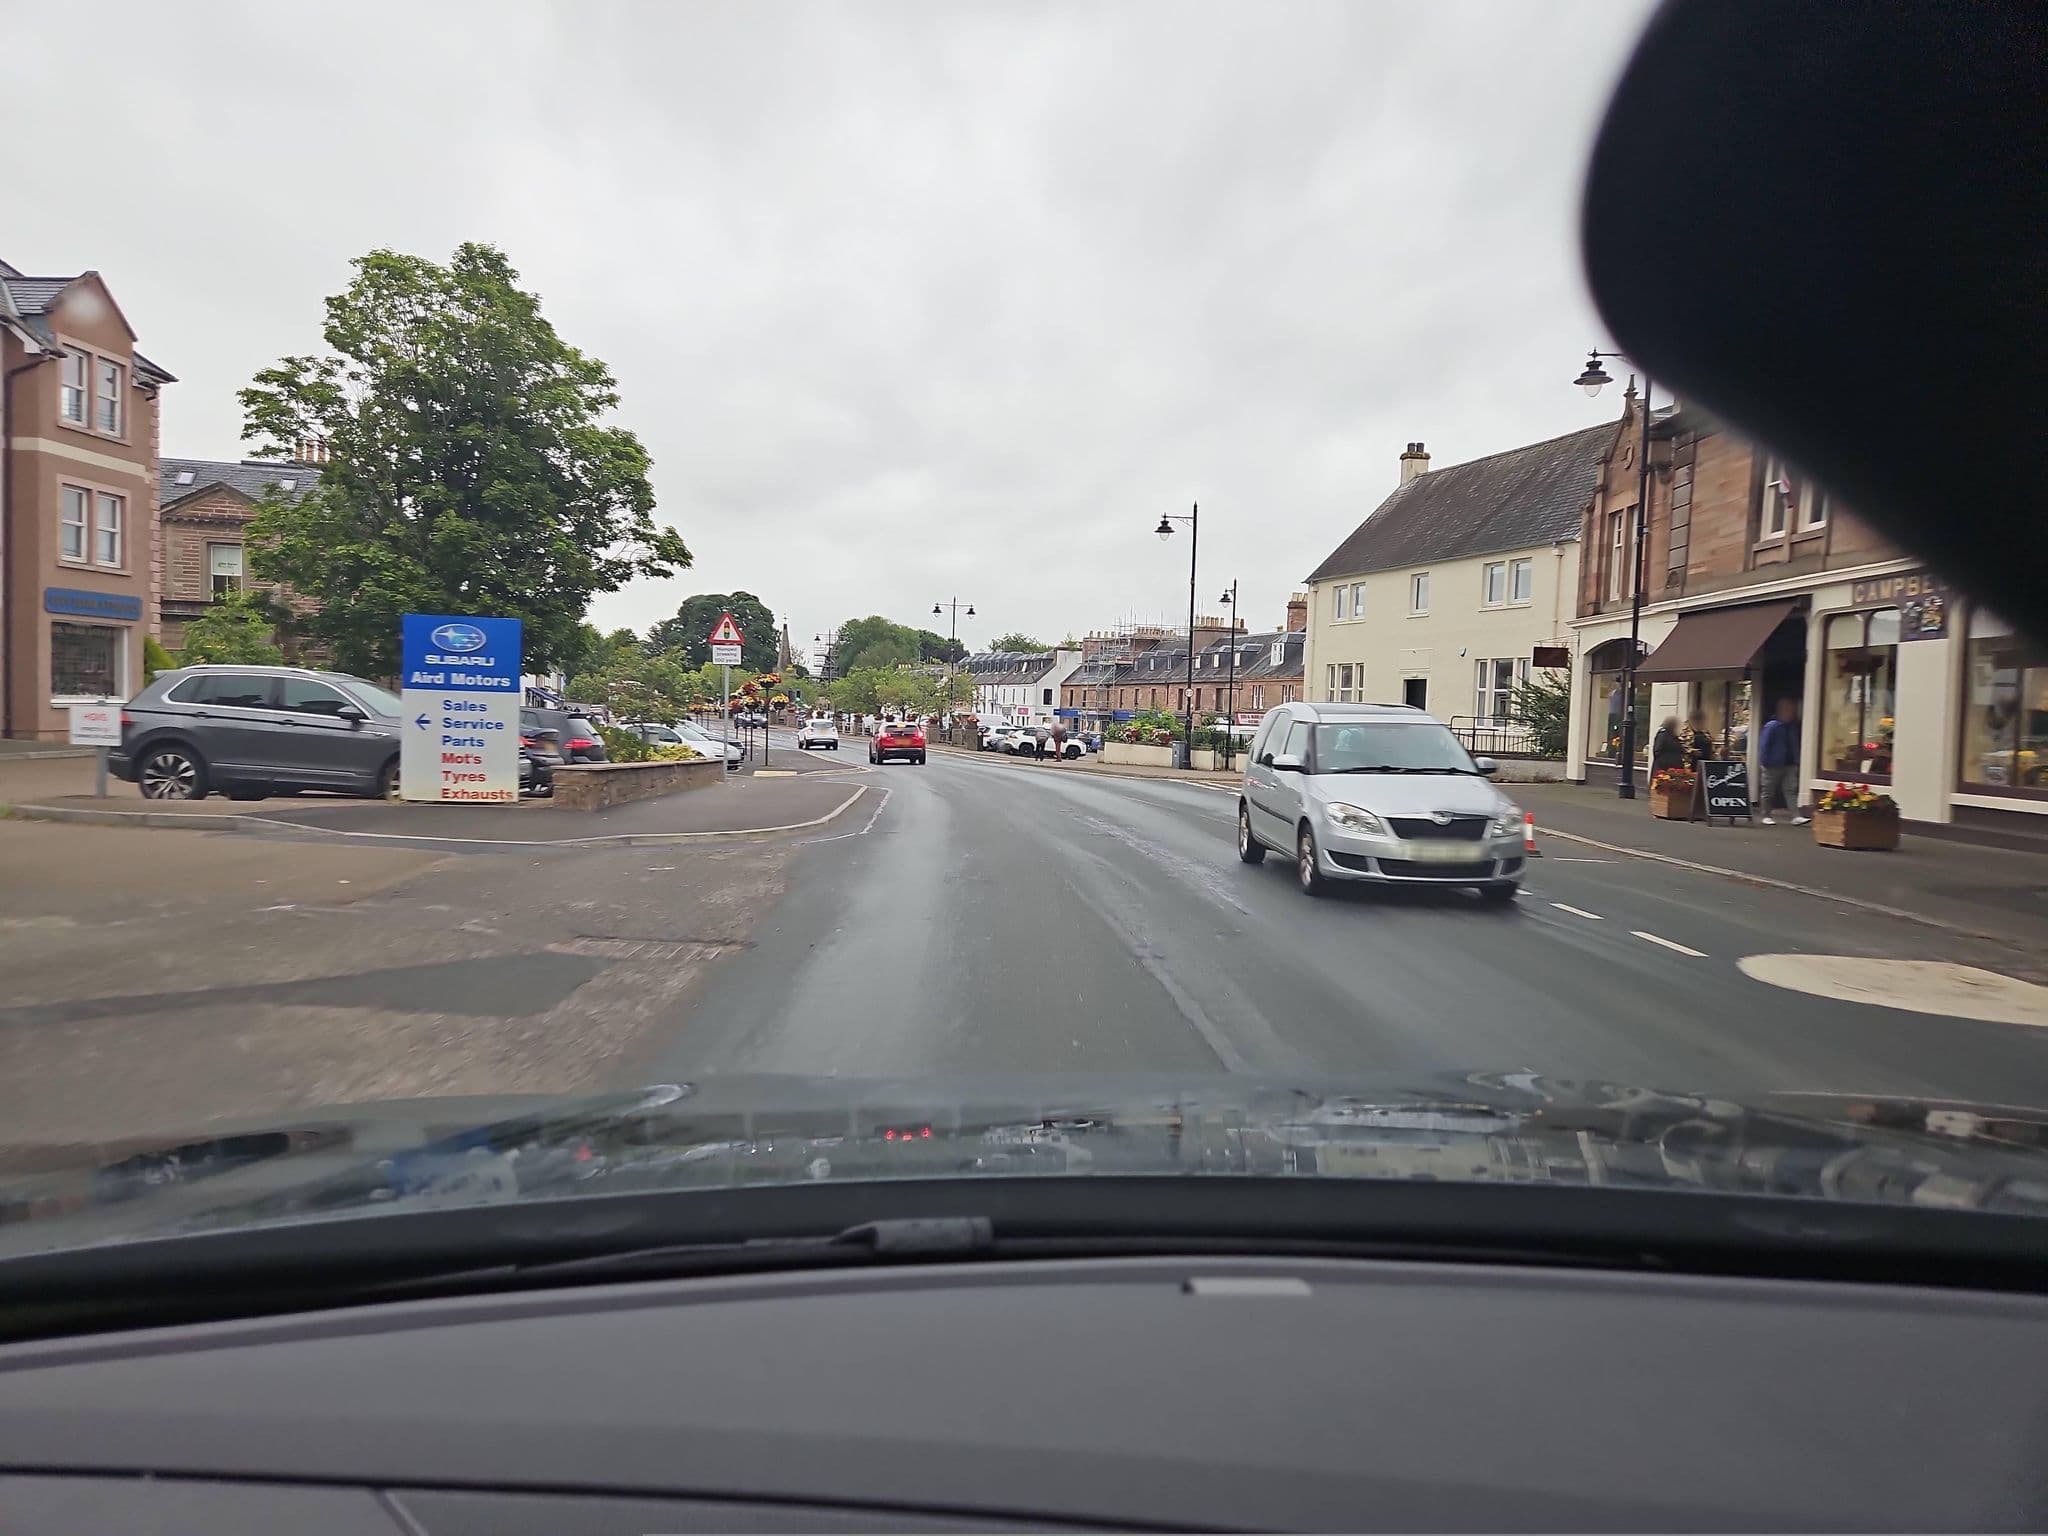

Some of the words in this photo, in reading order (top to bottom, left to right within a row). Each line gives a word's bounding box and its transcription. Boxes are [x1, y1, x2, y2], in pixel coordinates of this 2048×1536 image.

[425, 655, 495, 666] SUBARU
[411, 672, 444, 684] Aird
[451, 673, 511, 687] Motors
[443, 700, 487, 711] Sales
[443, 718, 504, 730] Service
[442, 735, 485, 746] Parts
[441, 753, 482, 764] Mot's
[442, 771, 486, 783] Tyres
[441, 788, 514, 800] Exhausts
[1711, 797, 1747, 807] OPEN
